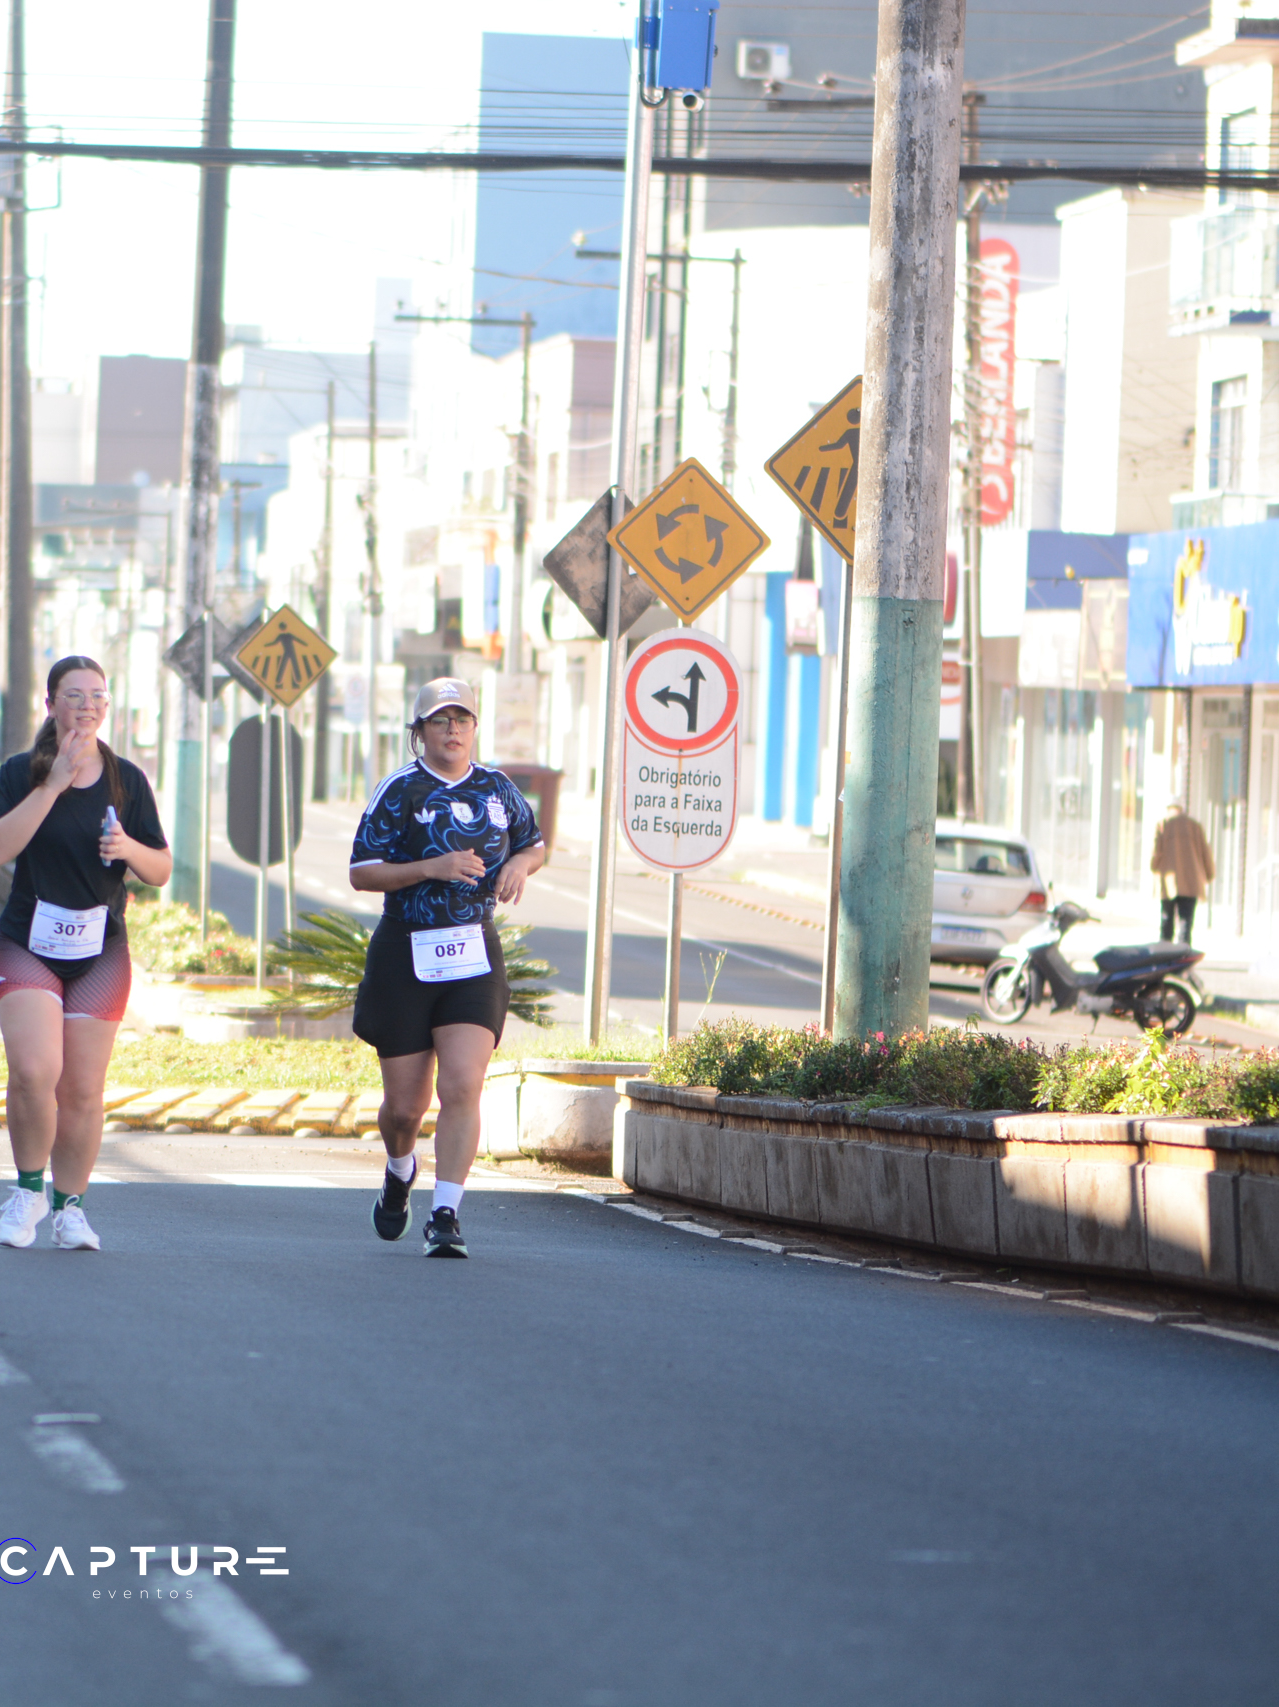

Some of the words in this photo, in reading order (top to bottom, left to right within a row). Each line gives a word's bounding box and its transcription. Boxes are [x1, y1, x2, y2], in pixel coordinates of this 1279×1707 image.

[638, 766, 722, 789] Obrigatório
[634, 794, 666, 811] para
[670, 796, 679, 809] a
[684, 793, 723, 813] Faixa
[631, 815, 649, 832] da
[653, 816, 723, 839] Esquerda
[53, 922, 87, 936] 307
[435, 942, 466, 958] 087
